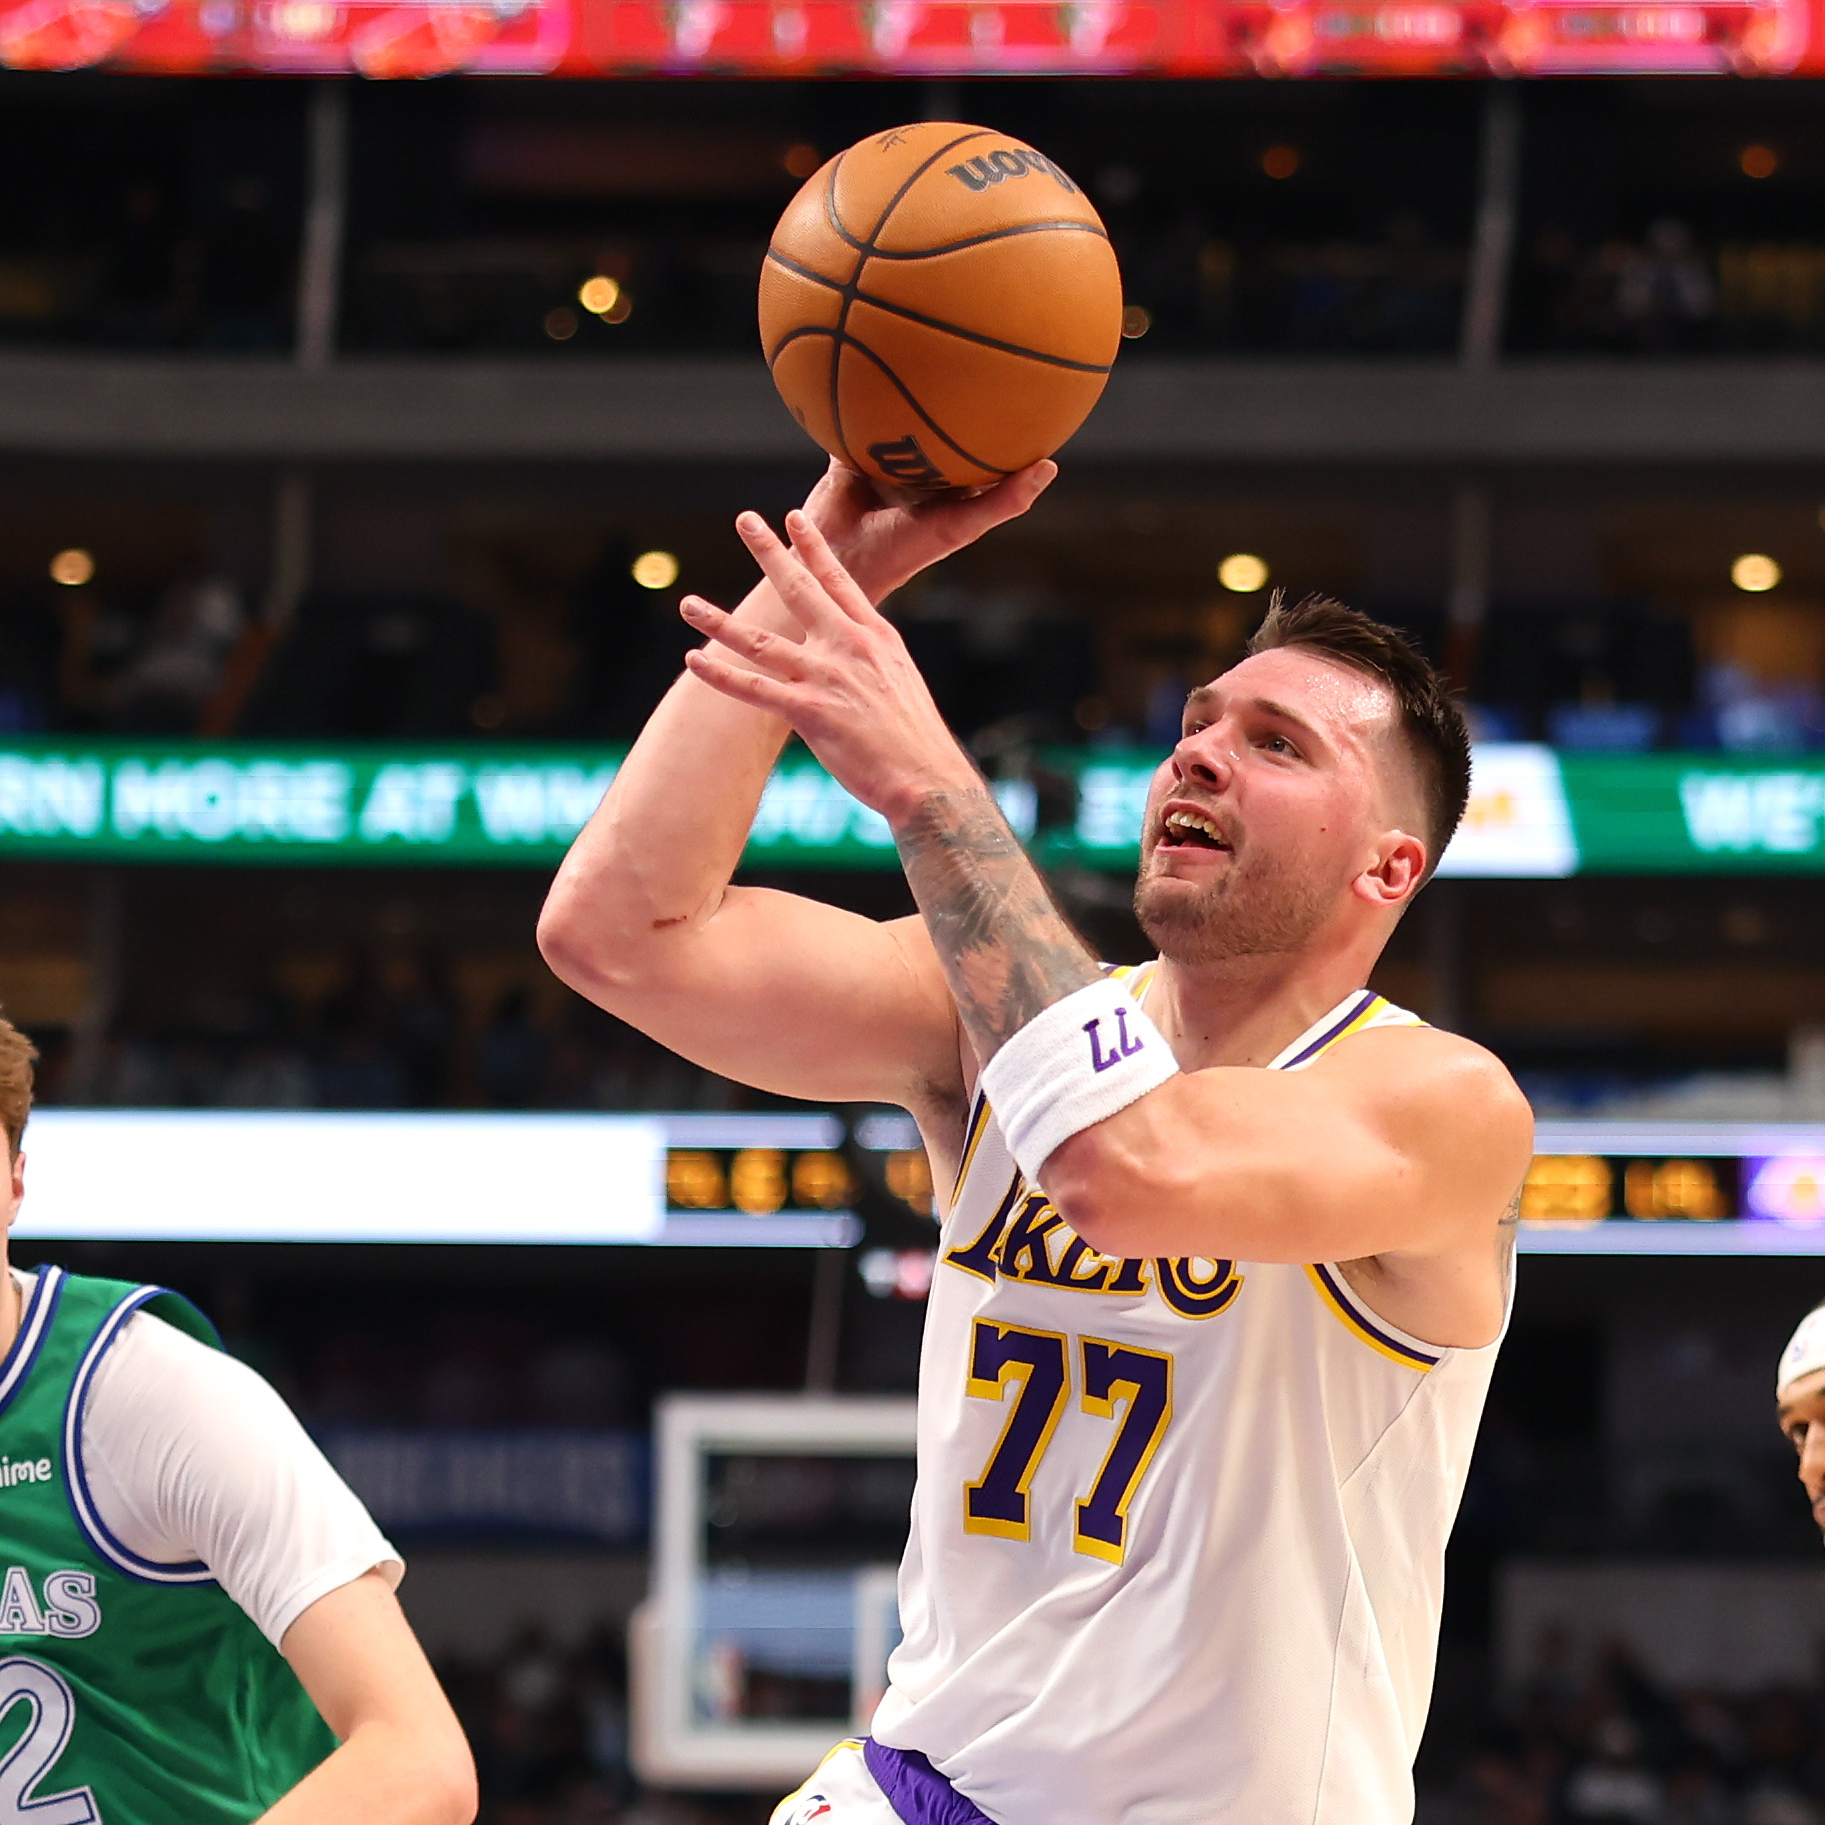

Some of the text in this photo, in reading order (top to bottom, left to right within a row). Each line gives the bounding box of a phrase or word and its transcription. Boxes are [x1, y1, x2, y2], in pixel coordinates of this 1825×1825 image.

[113, 760, 347, 840] MORE
[361, 762, 463, 840] AT
[963, 1315, 1175, 1566] 77
